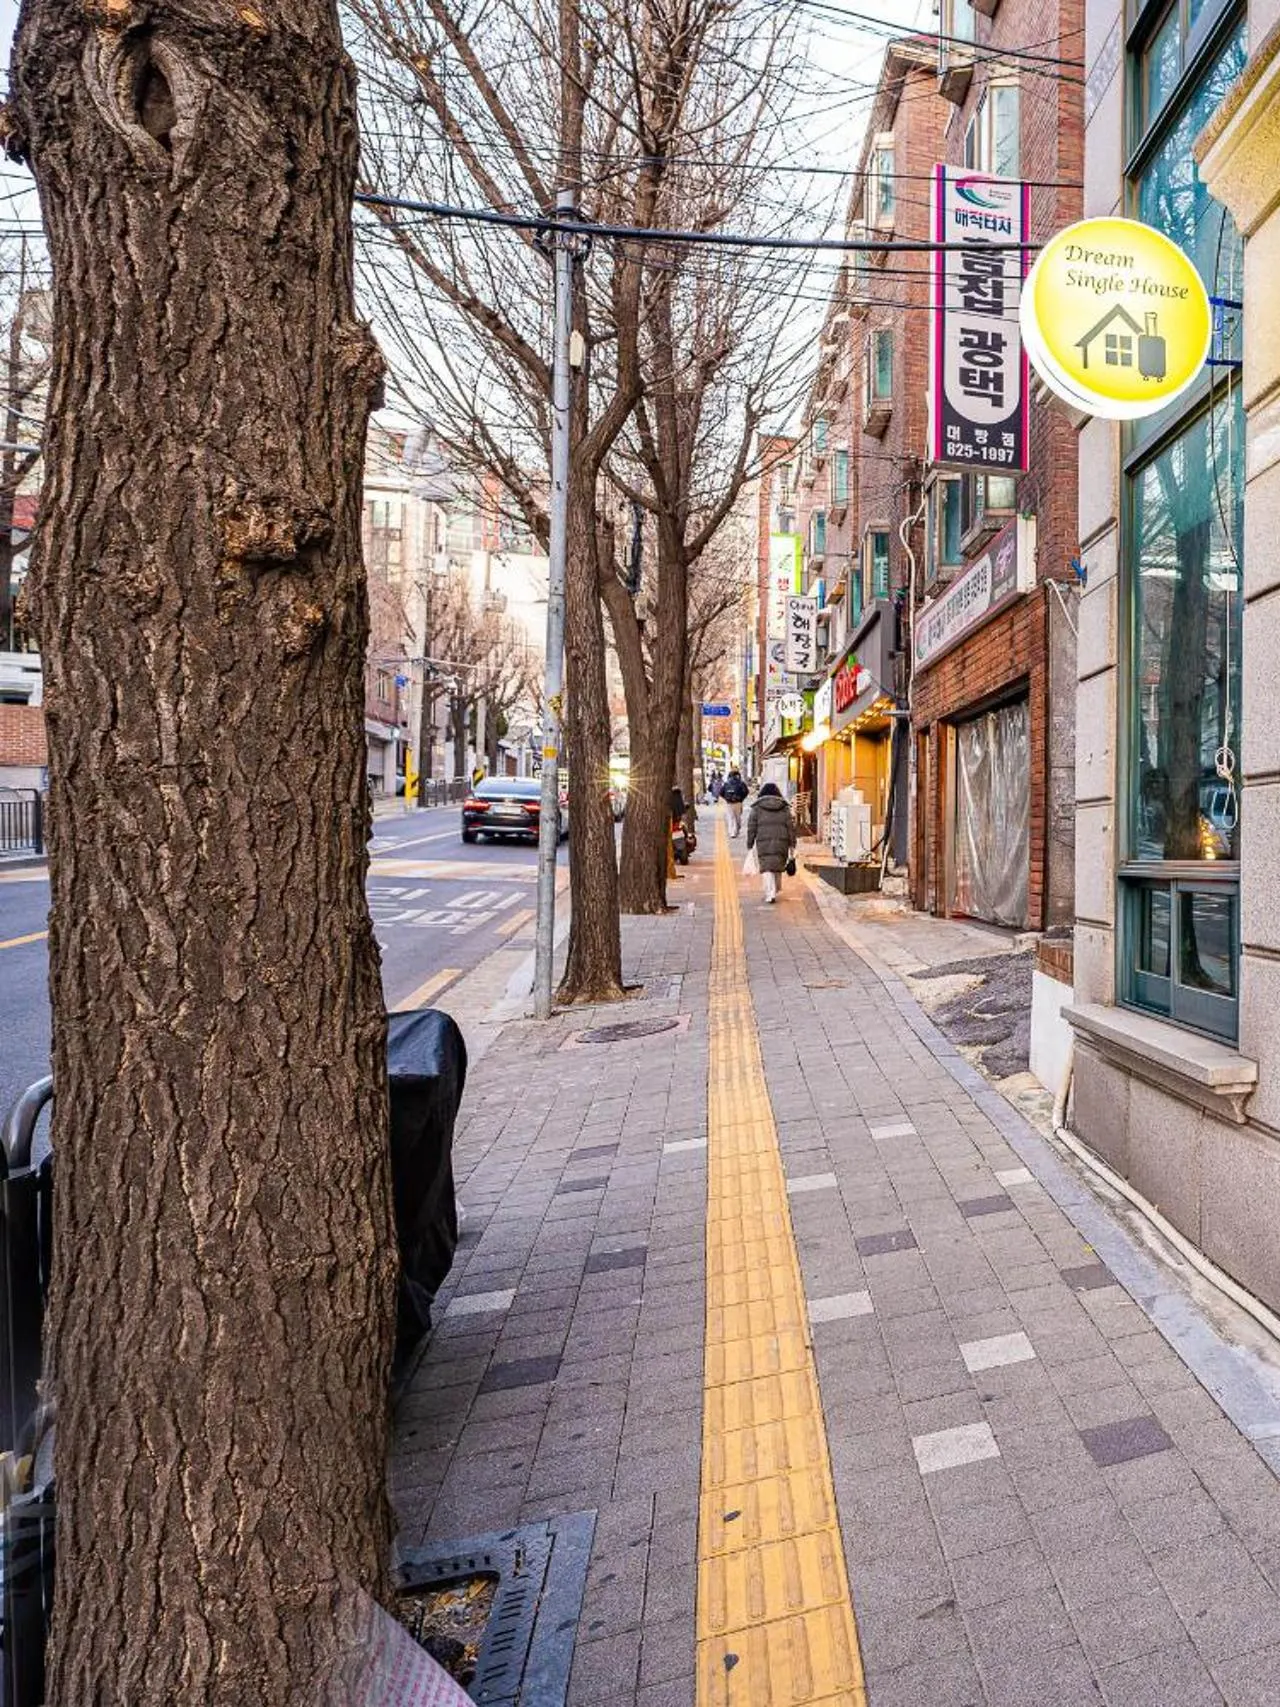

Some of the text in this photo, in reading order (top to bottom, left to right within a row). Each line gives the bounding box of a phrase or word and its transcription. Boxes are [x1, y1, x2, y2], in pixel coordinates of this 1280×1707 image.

[1065, 245, 1134, 268] Dream
[1066, 269, 1189, 300] Single House
[958, 327, 1007, 408] 광택
[946, 442, 1014, 462] 825-1997
